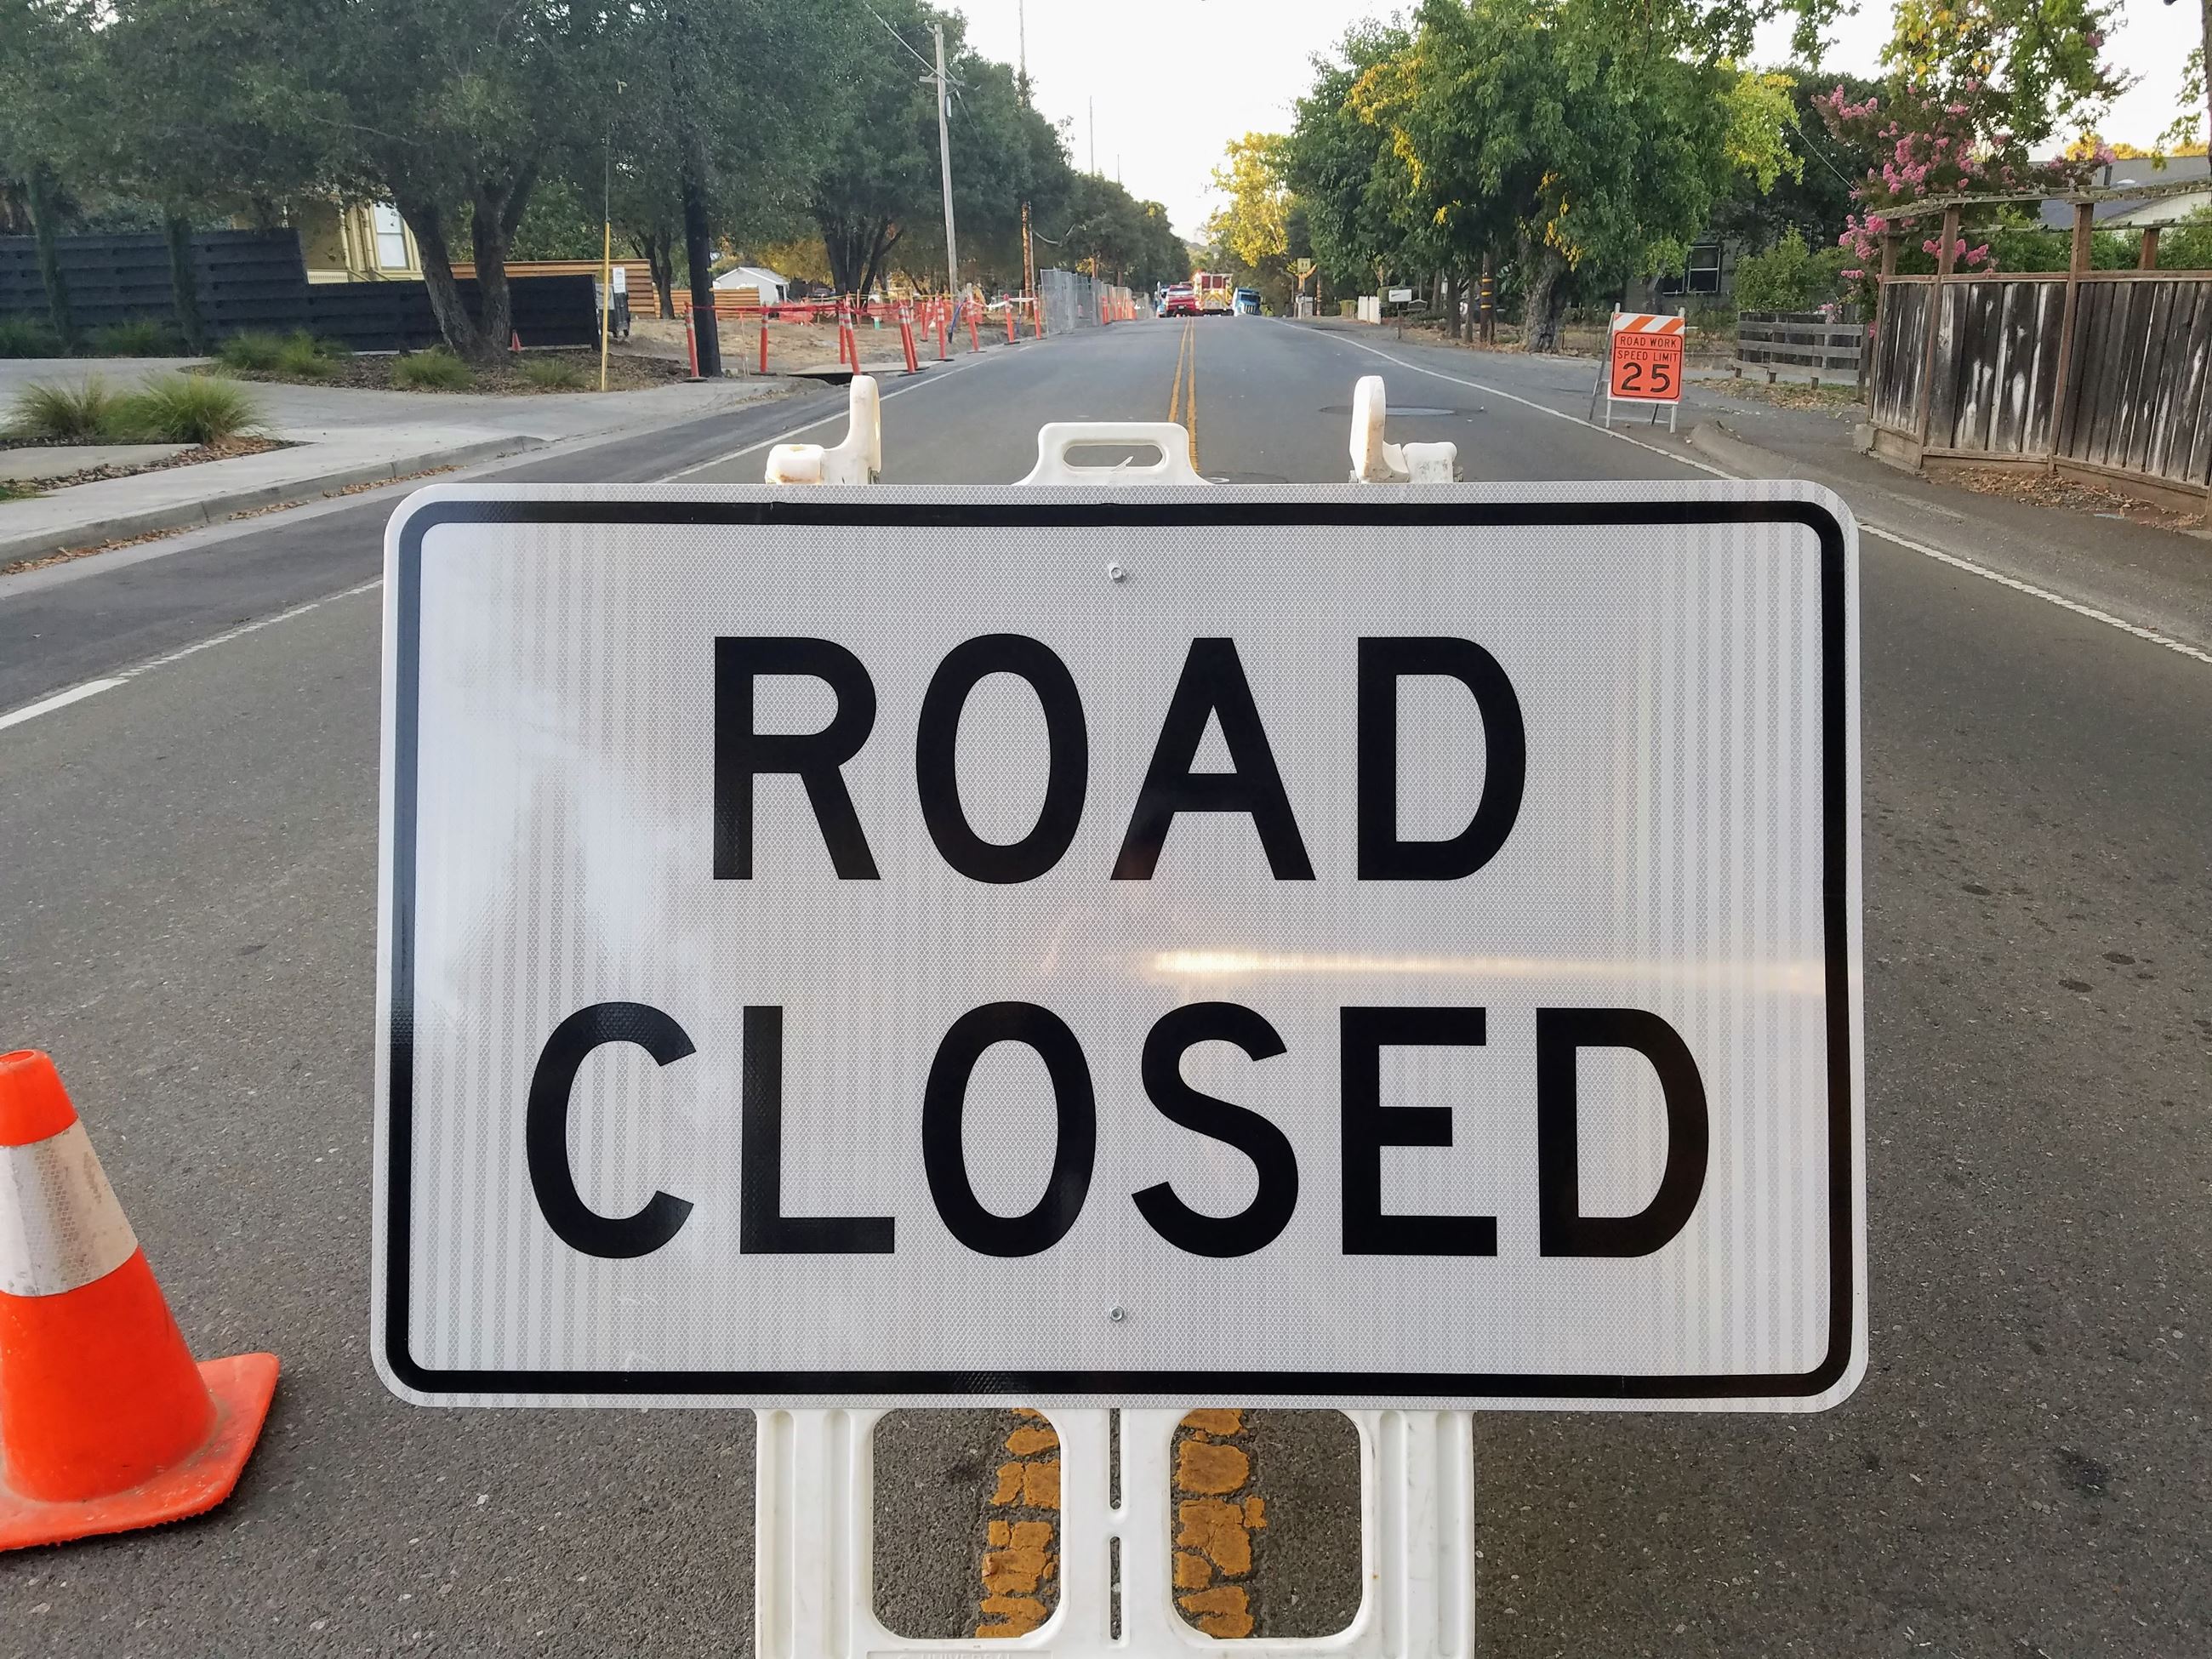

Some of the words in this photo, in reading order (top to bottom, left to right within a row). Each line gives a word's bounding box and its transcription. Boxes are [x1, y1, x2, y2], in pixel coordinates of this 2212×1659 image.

[1617, 350, 1648, 361] SPEED
[1653, 351, 1679, 362] LIMIT
[1620, 336, 1646, 346] ROAD
[1650, 338, 1677, 348] WORK
[1621, 362, 1671, 393] 25
[714, 634, 1526, 884] ROAD
[527, 1001, 1708, 1258] CLOSED
